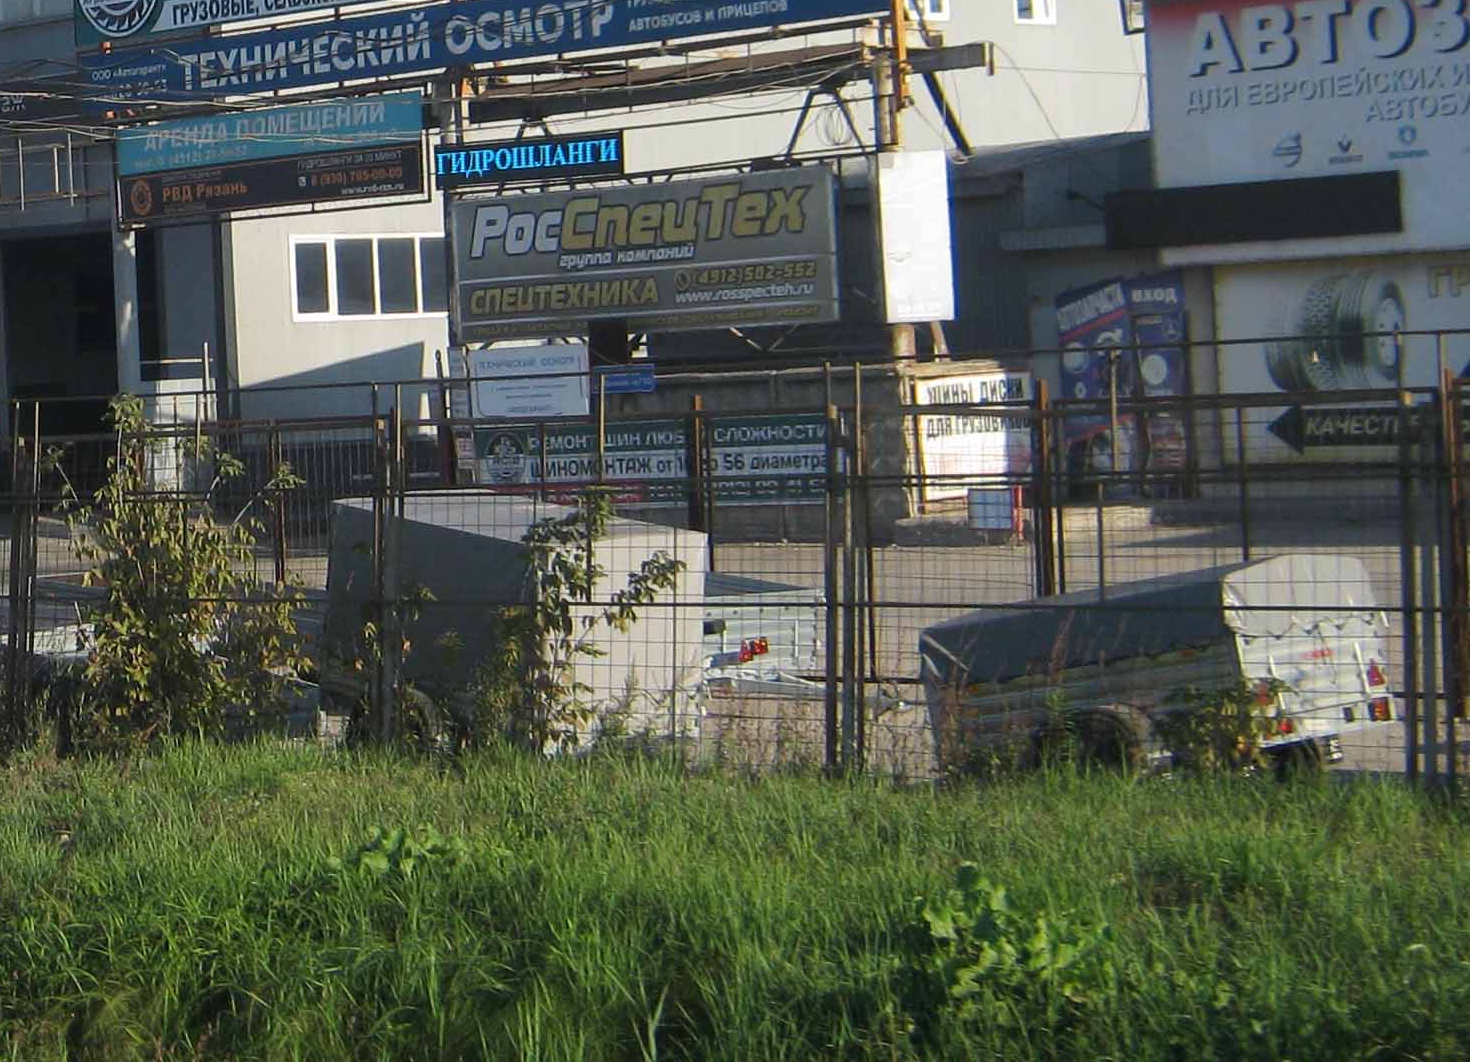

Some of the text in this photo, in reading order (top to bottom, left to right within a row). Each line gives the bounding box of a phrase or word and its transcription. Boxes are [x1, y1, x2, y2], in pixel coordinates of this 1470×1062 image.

[628, 10, 702, 33] АВТОБУСОВ
[180, 11, 431, 91] ТЕХНИЧЕСКИЙ
[92, 68, 111, 81] ООО
[1186, 86, 1240, 116] ДЛЯ
[1248, 66, 1445, 107] ЕВРОПЕЙСКИХ
[436, 138, 619, 178] ГИДРОШЛАНГИ
[162, 182, 249, 204] РВД Рязань
[470, 181, 815, 259] РосСпецТех
[559, 244, 695, 270] группа компаний
[471, 276, 658, 316] СПЕЦТЕХНИКА
[675, 282, 813, 303] www.rosspecteh.ru
[1132, 287, 1179, 305] ВХОД
[927, 378, 1024, 405] ШИНЫ ДИСКИ
[927, 415, 952, 441] ДЛЯ
[723, 452, 746, 471] 56
